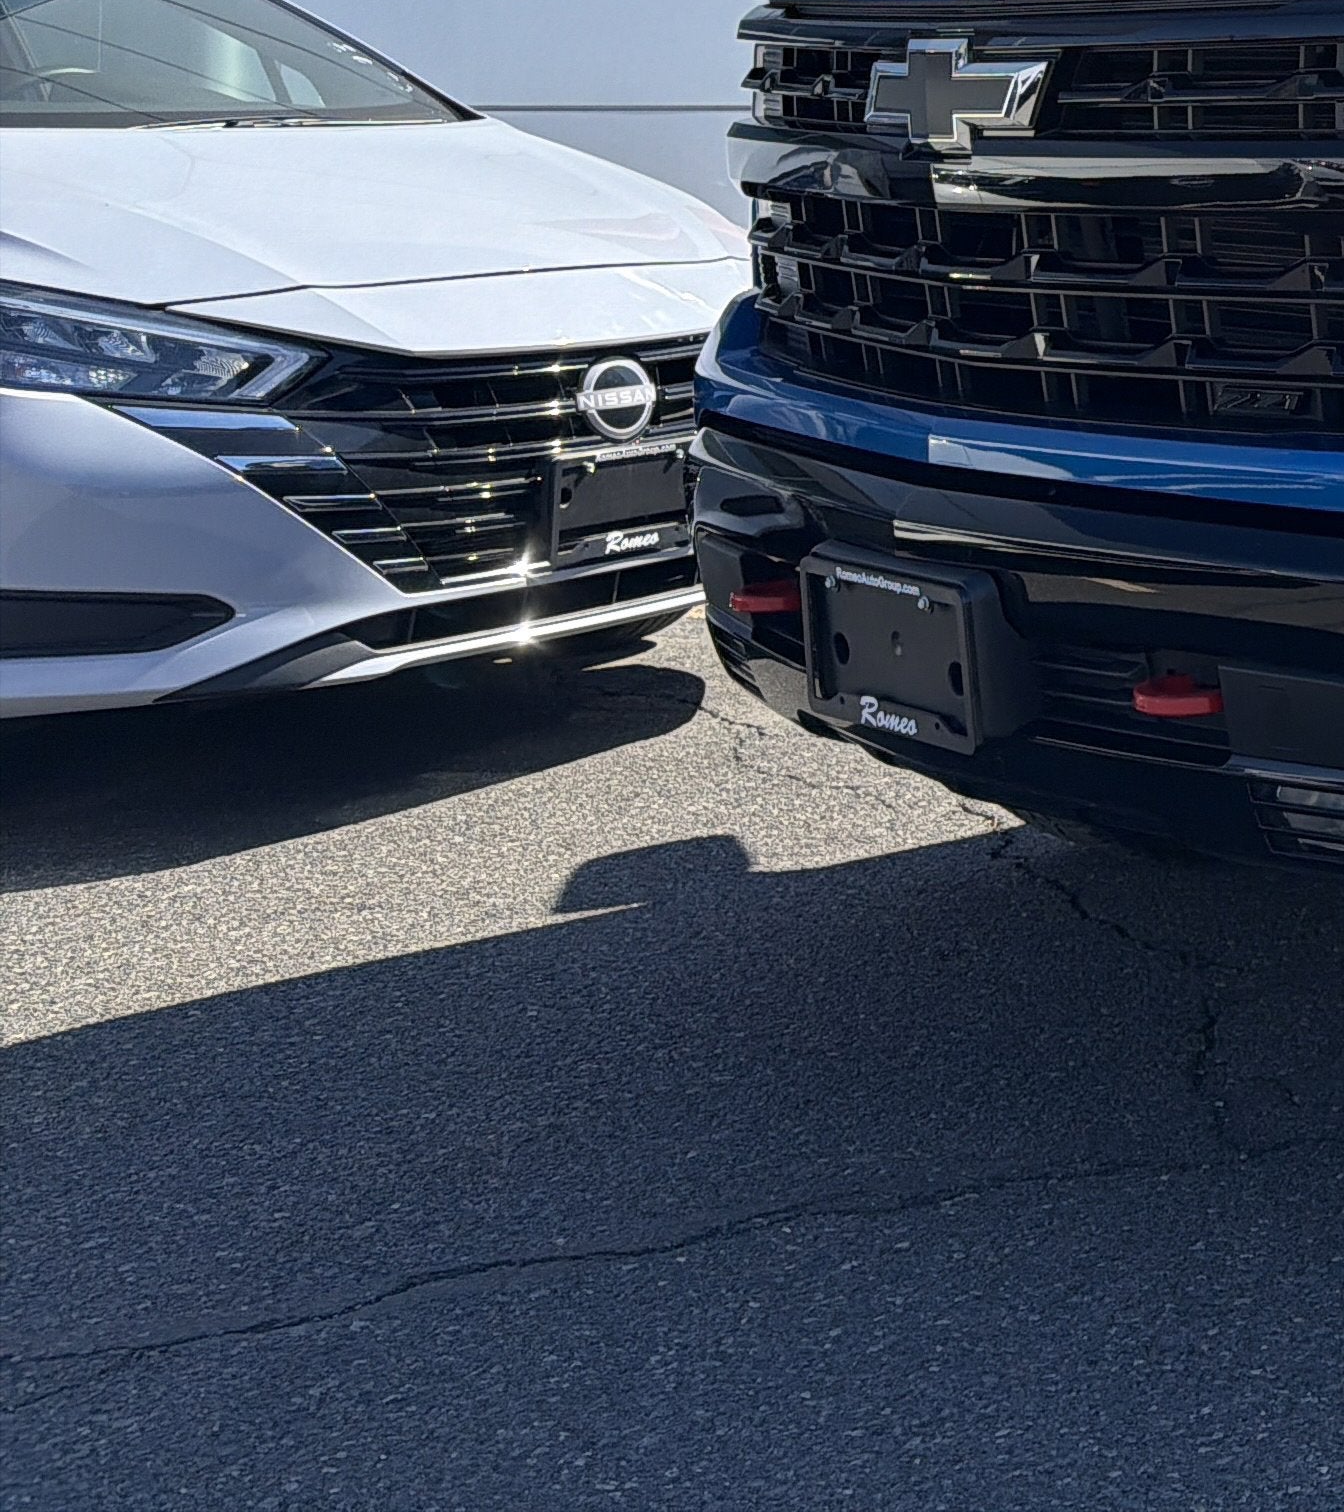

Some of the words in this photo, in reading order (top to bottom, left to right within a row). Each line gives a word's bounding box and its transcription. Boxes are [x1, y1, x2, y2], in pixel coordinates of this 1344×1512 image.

[579, 387, 655, 409] NISSAN
[604, 530, 659, 555] Romeo
[835, 566, 920, 597] RomeoAutoGroup.com
[860, 695, 917, 736] Romeo
